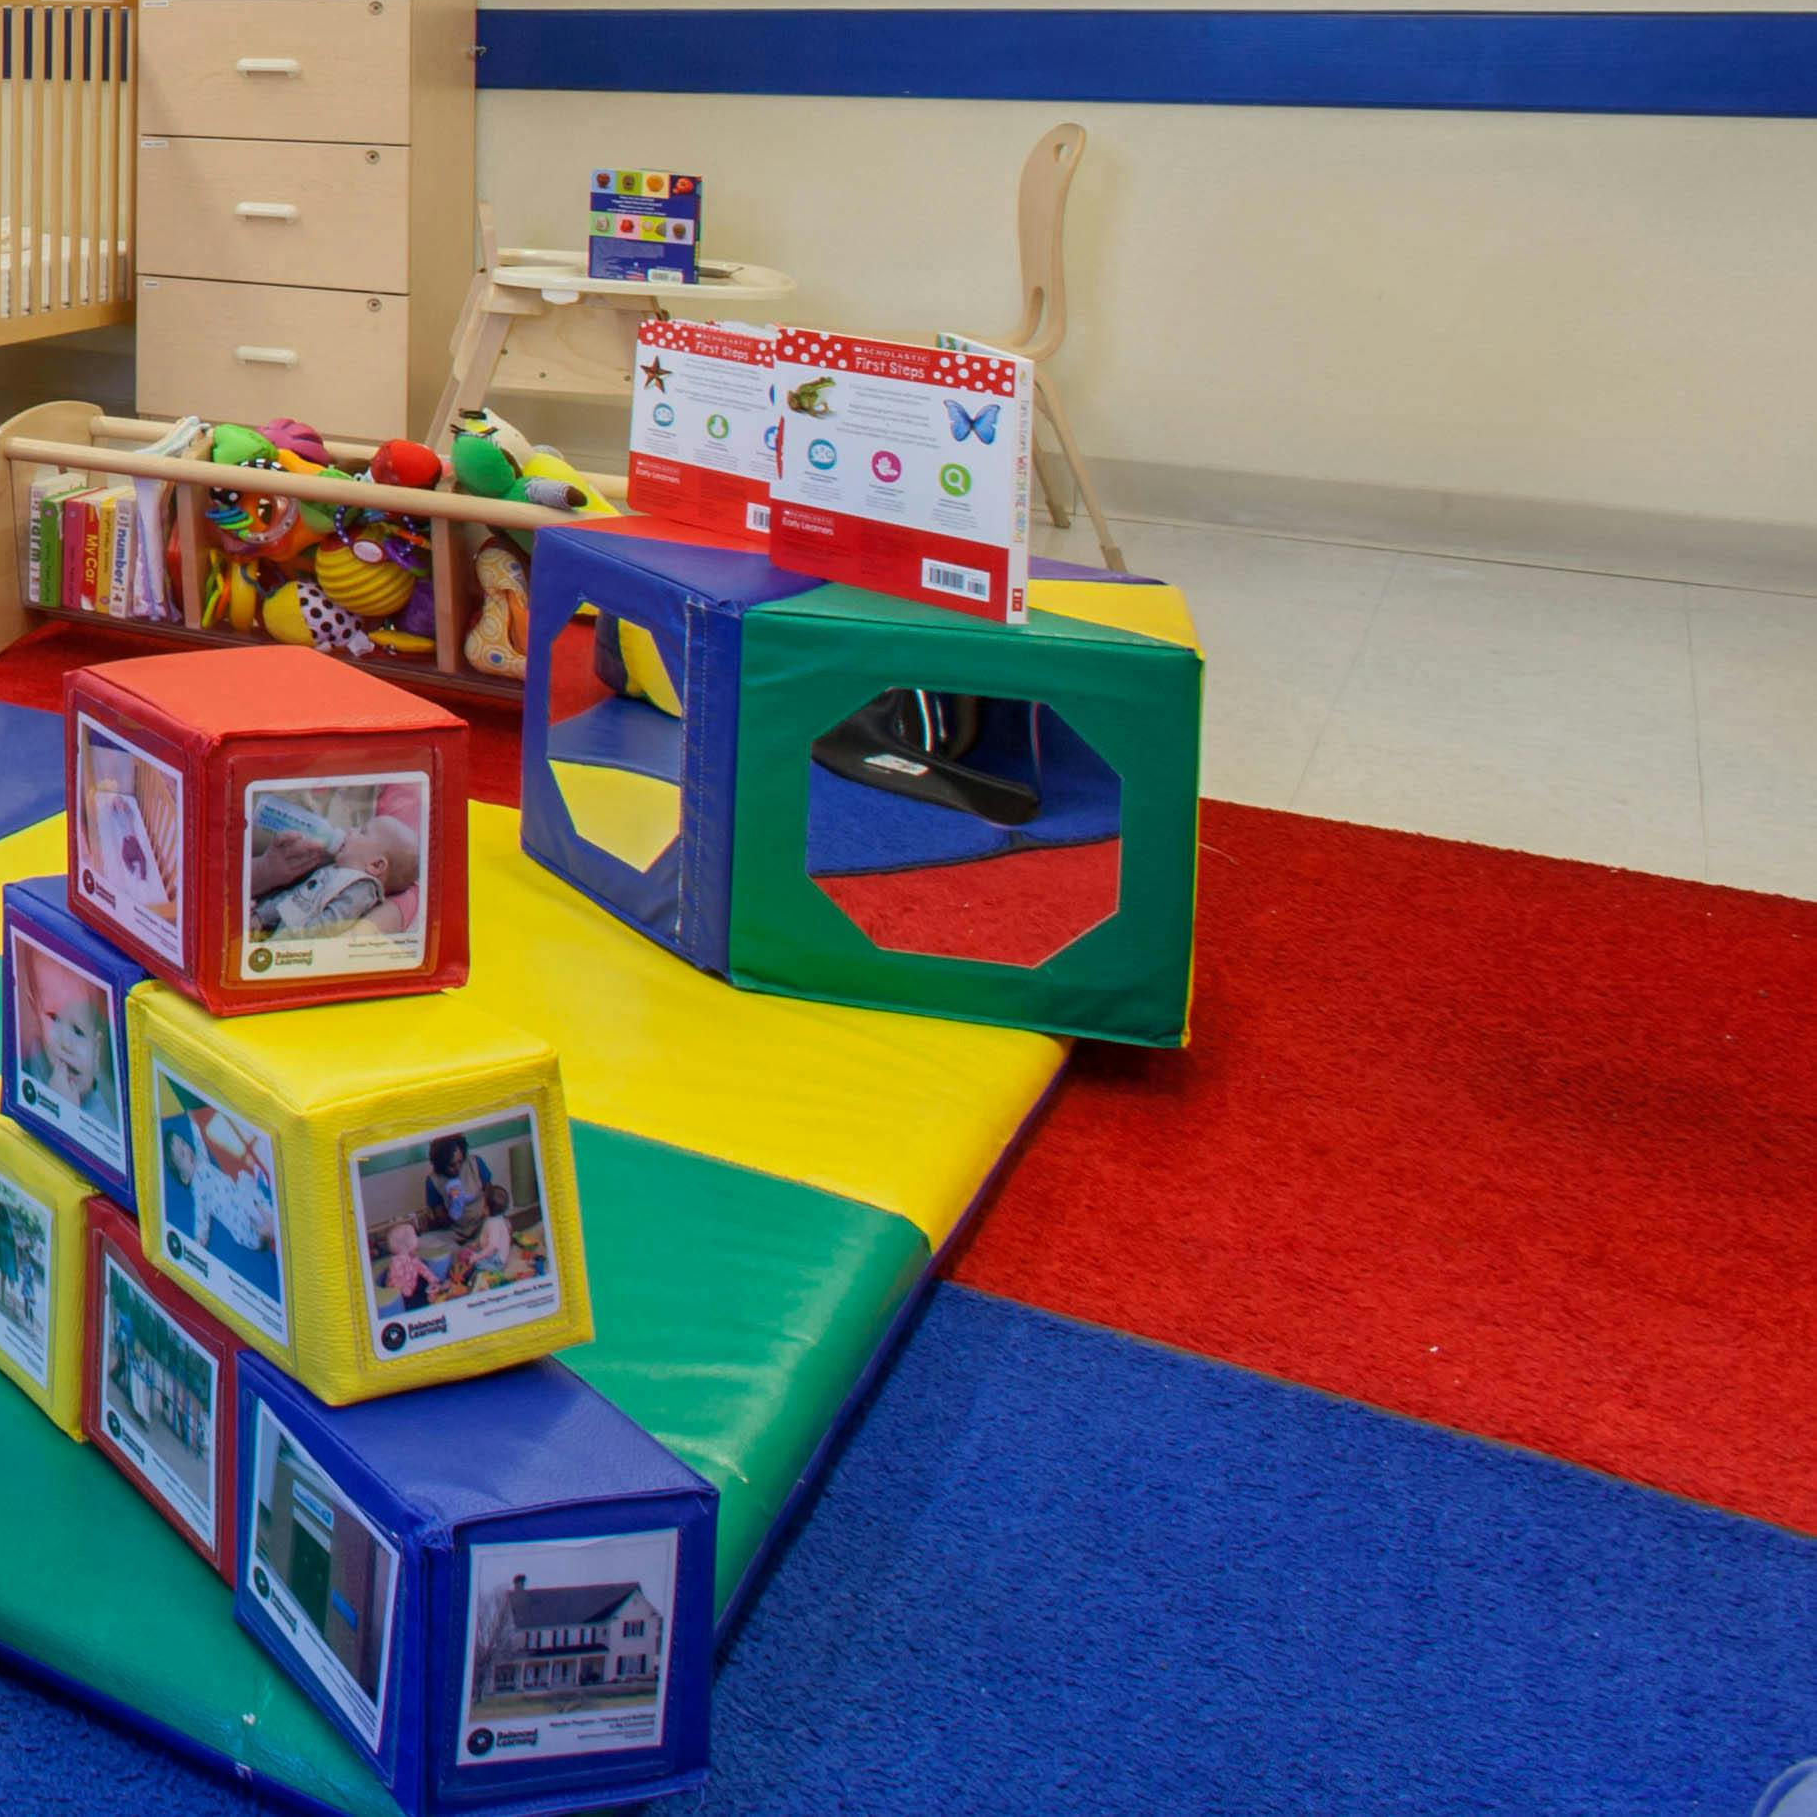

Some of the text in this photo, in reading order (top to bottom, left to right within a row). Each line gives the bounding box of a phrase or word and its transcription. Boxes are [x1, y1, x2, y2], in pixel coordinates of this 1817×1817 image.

[695, 340, 750, 361] First Steps
[863, 347, 930, 364] SCHOLASTIC
[854, 357, 926, 381] First Steps
[781, 516, 835, 536] Early Learners
[84, 533, 98, 584] My Car
[114, 528, 130, 585] number
[275, 949, 313, 960] Balanced
[275, 956, 313, 967] Learning
[408, 1314, 446, 1331] Balanced
[408, 1323, 447, 1340] Learning
[496, 1728, 538, 1740] Balanced
[496, 1737, 539, 1748] Learning
